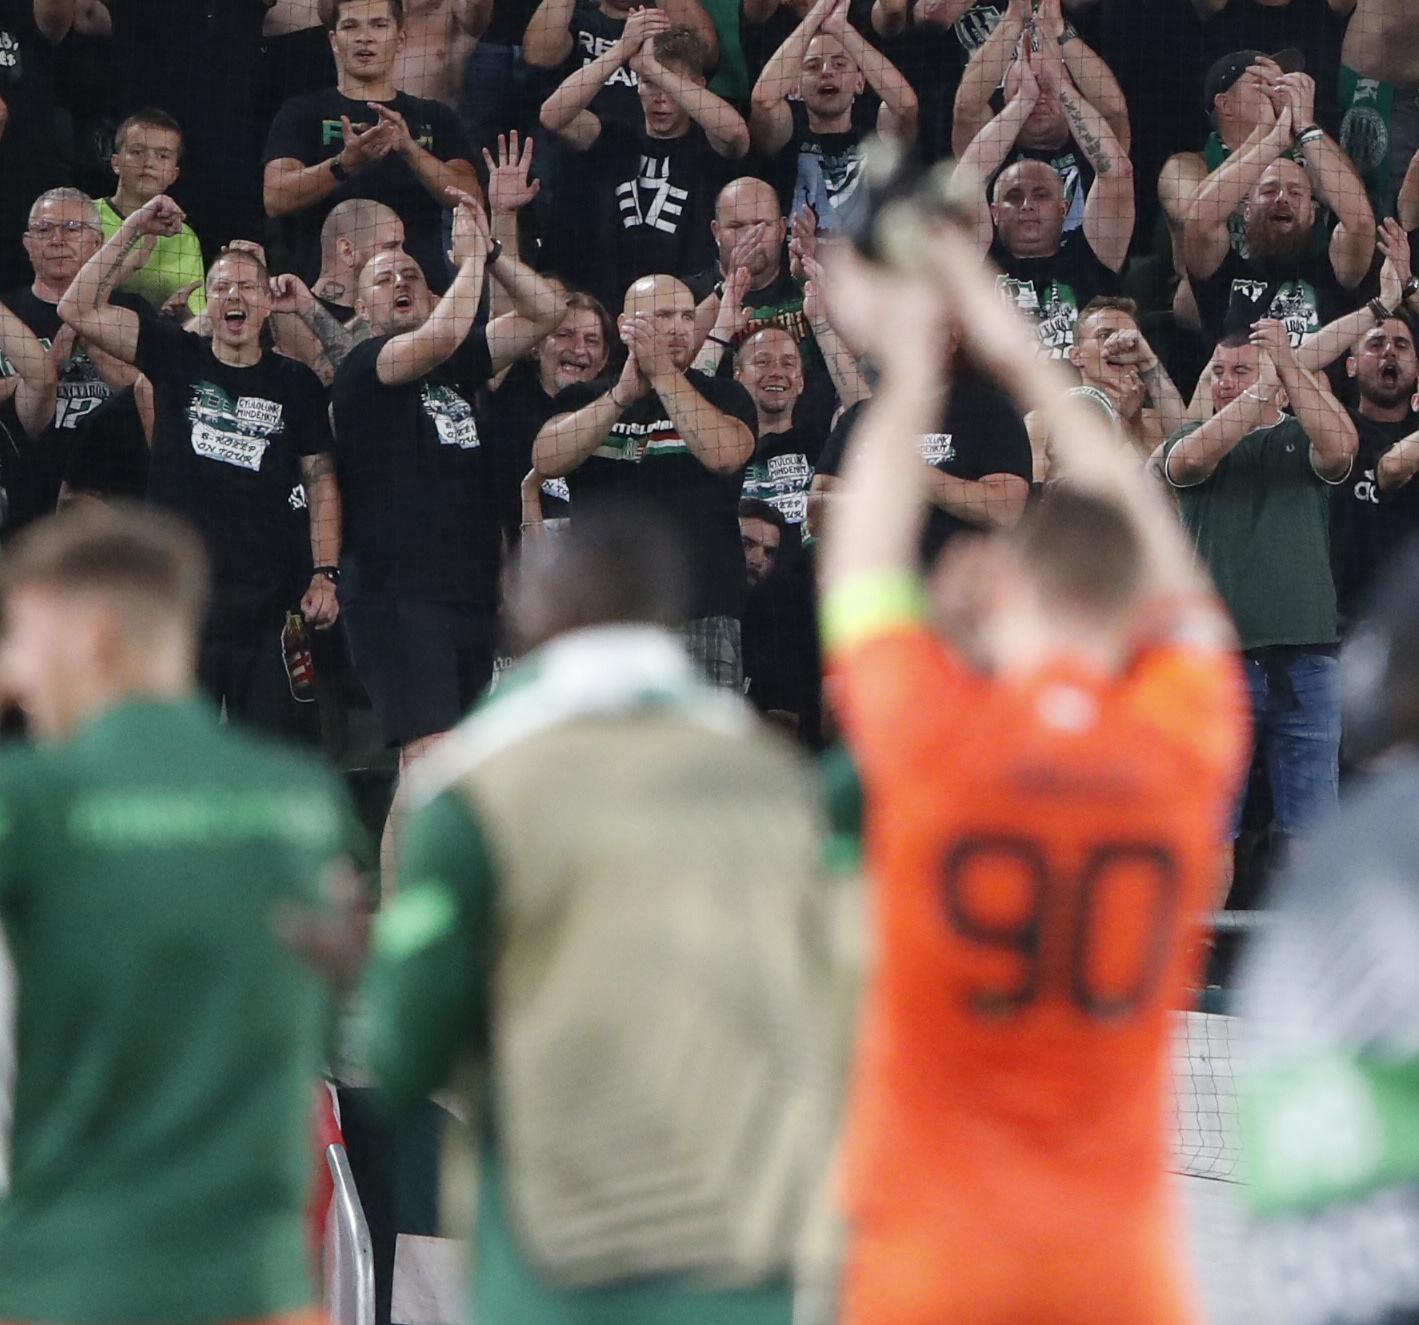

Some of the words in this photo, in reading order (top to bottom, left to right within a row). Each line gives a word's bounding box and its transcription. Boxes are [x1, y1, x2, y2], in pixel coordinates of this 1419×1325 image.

[198, 442, 216, 452] ON
[218, 448, 253, 465] TOUR
[941, 829, 1178, 1020] 90
